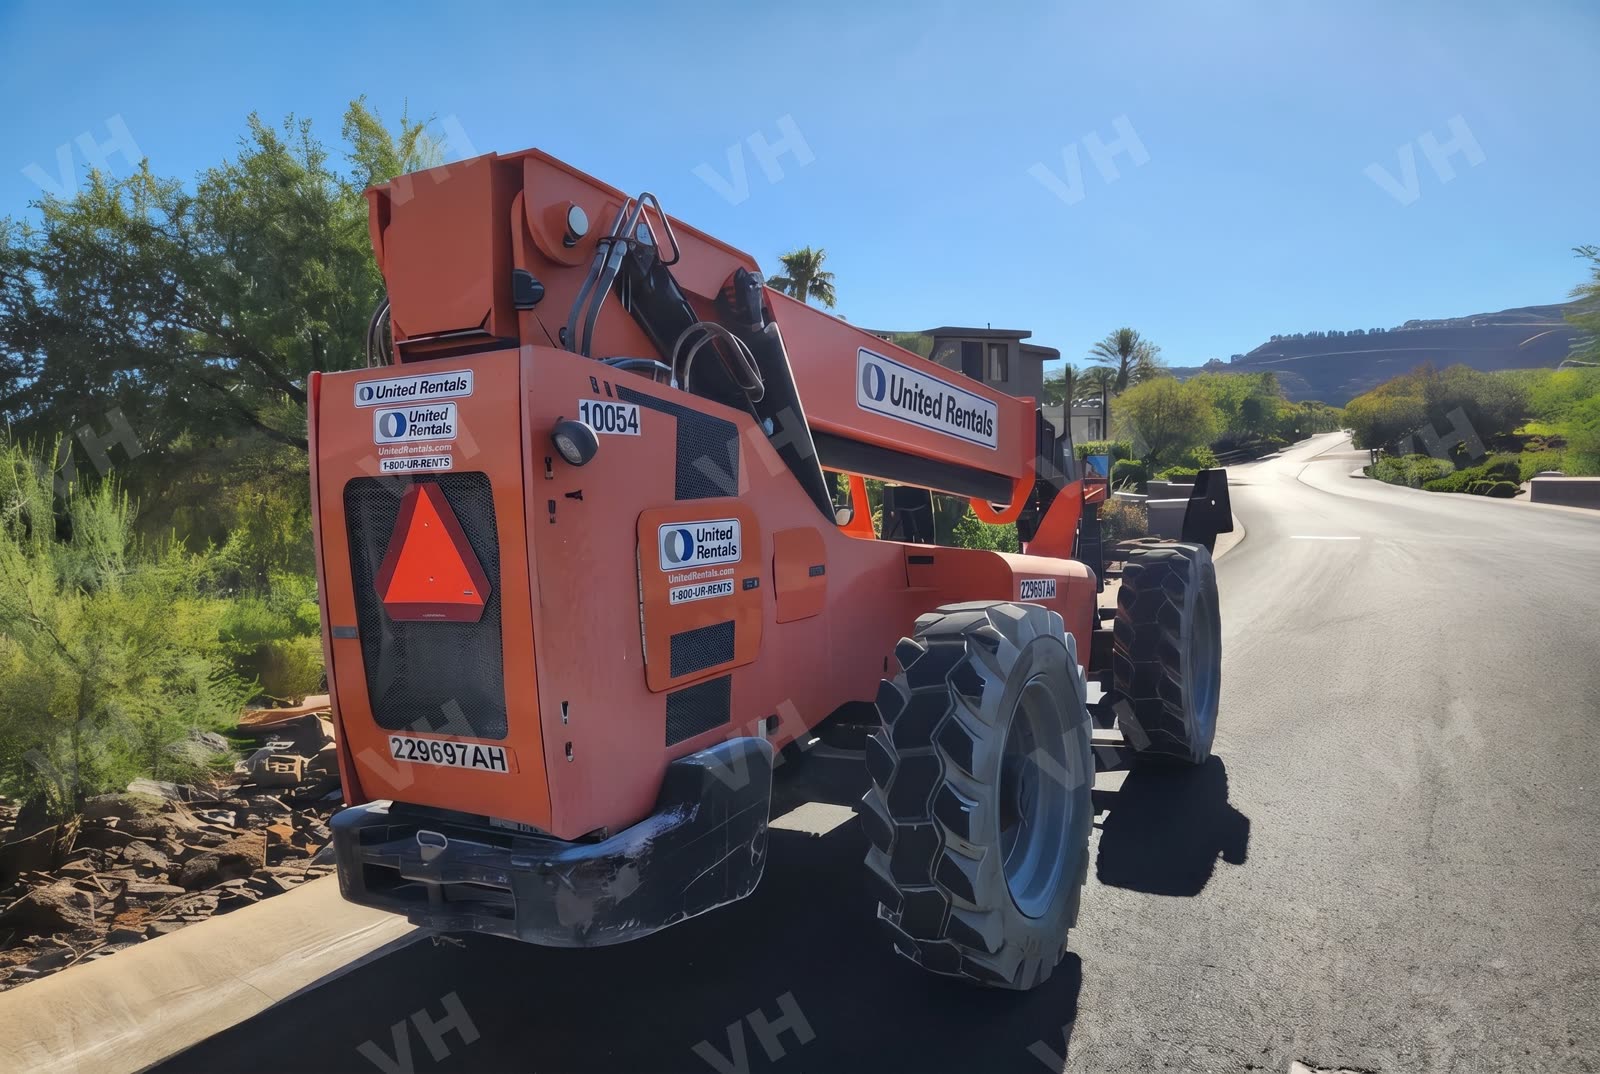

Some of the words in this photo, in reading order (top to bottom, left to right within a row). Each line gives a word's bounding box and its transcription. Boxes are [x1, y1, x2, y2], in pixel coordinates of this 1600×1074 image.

[375, 382, 417, 399] United
[419, 376, 467, 395] Rentals
[409, 407, 449, 423] United
[890, 374, 943, 420] United
[945, 395, 993, 438] Rentals
[580, 401, 639, 434] 10054
[409, 422, 452, 437] Rentals
[378, 444, 452, 456] UnitedRentals.com
[383, 457, 450, 470] 1-800-UR-RENTS
[696, 525, 733, 543] United
[696, 542, 737, 560] Rentals
[668, 567, 735, 584] UnitedRentals.com
[671, 582, 732, 601] 1-800-UR-RENTS
[391, 737, 506, 771] 229697AH
